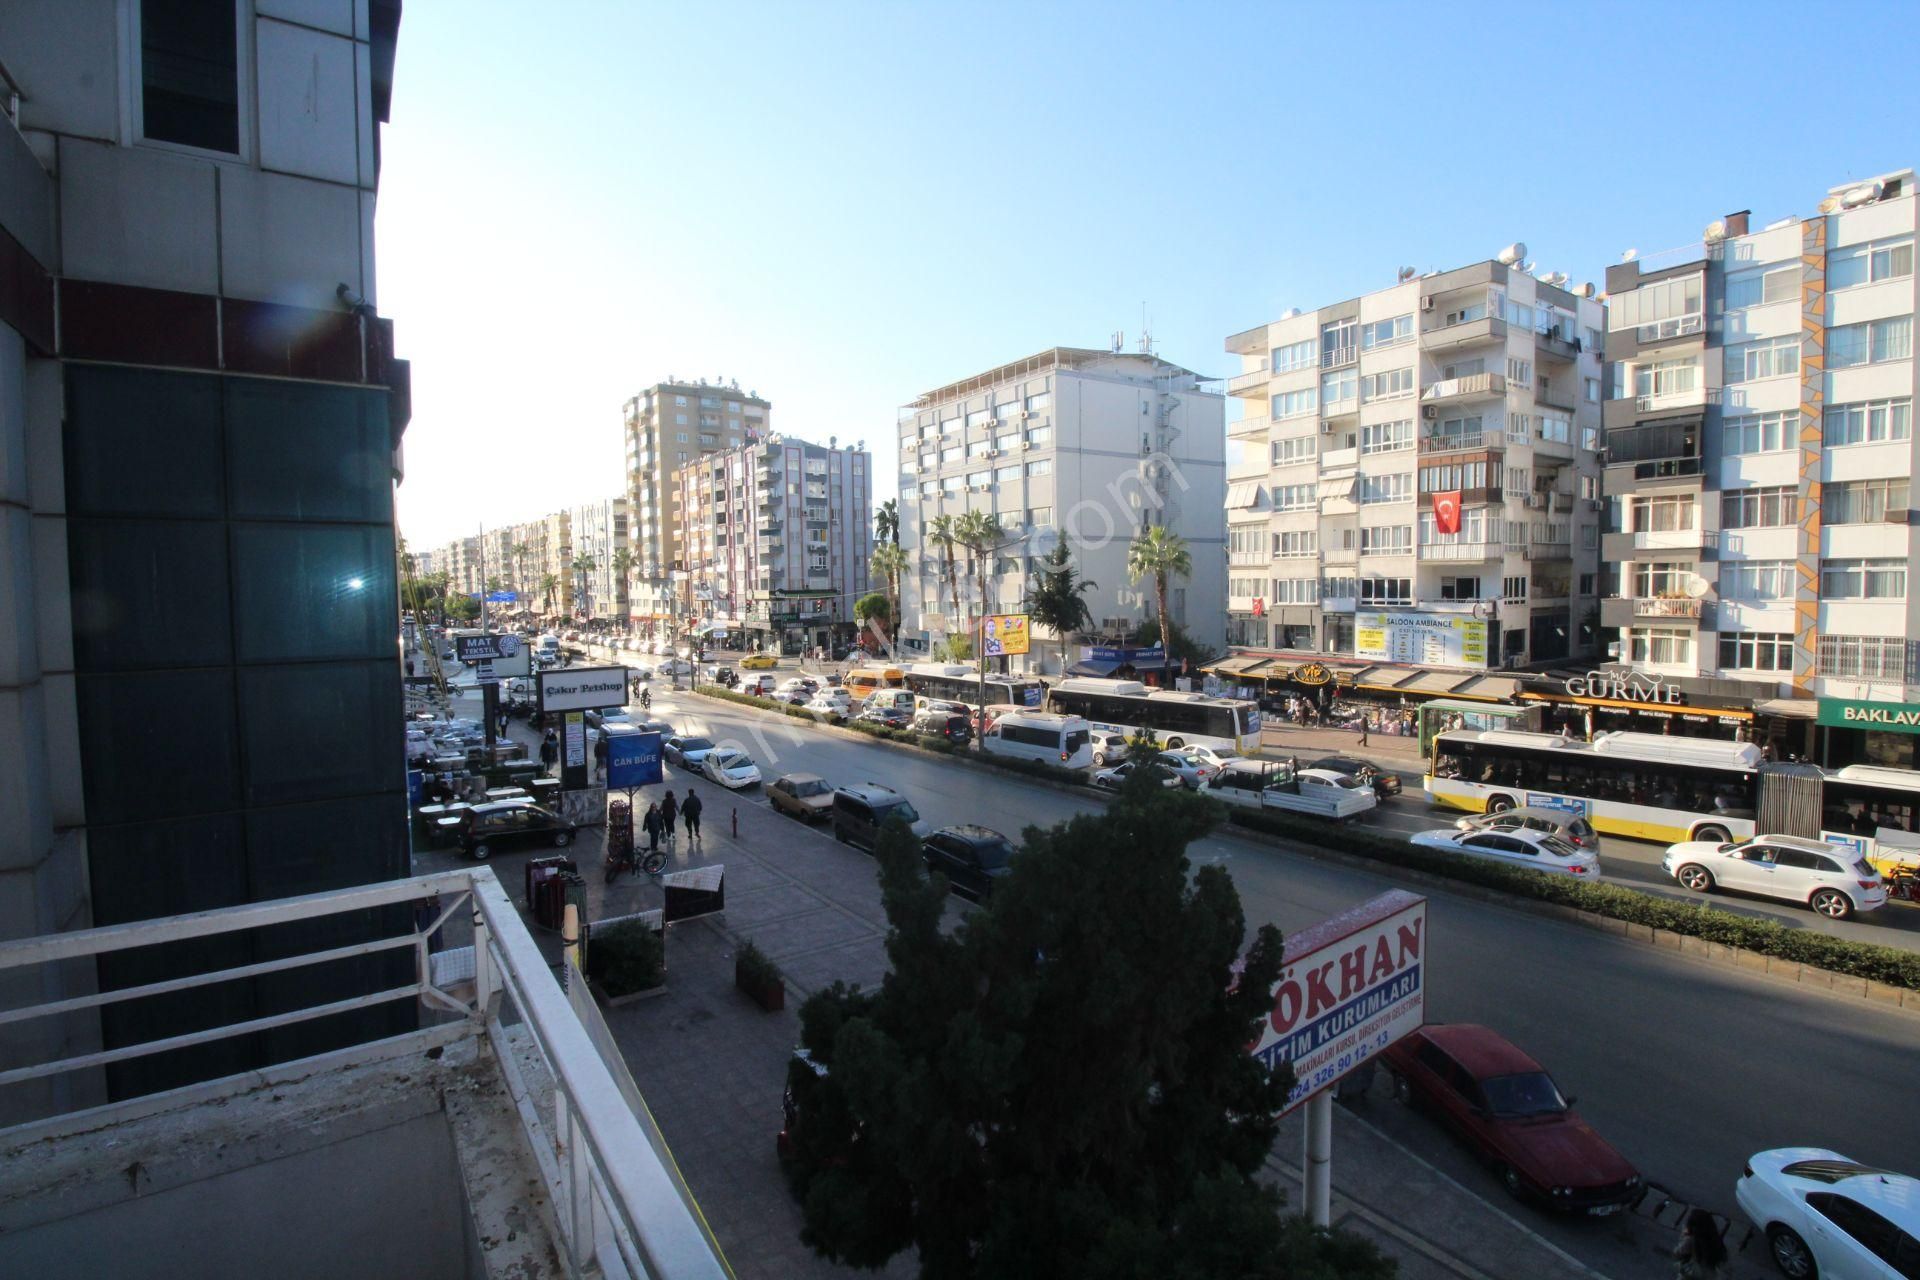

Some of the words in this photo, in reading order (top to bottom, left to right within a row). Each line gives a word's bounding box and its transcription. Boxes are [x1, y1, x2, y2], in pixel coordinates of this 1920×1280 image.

[1387, 618, 1414, 626] SALOON
[1416, 620, 1453, 628] AMBIANCE
[467, 638, 492, 647] MAT
[545, 686, 577, 697] Çakır
[580, 682, 622, 693] Petshop
[614, 758, 632, 766] CAN
[634, 754, 657, 764] BÜFE
[1318, 972, 1415, 1044] KURUMLARI
[1313, 1064, 1335, 1087] 326
[1337, 1053, 1351, 1072] 90
[1354, 1043, 1367, 1060] 12
[1375, 1030, 1388, 1046] 13
